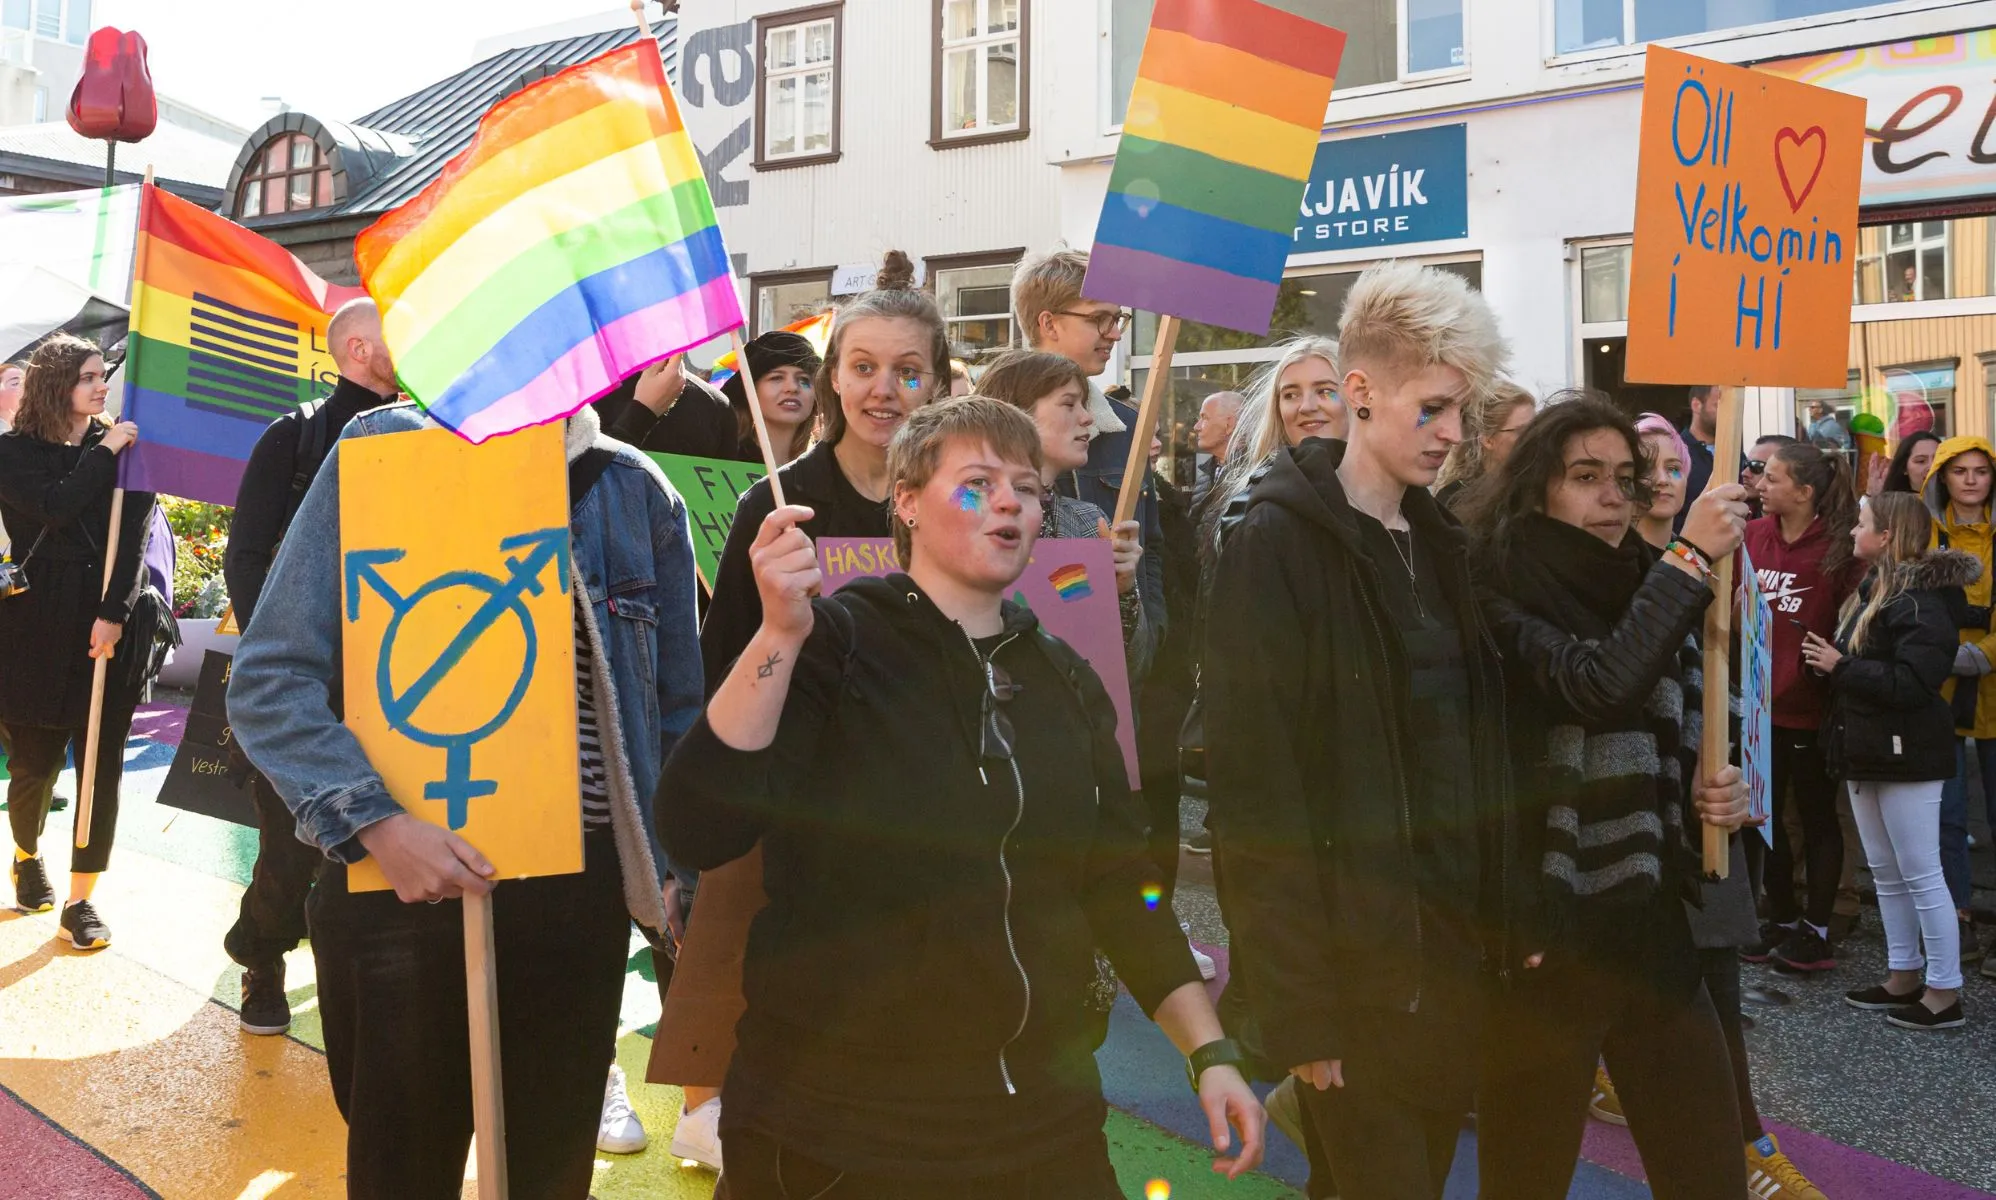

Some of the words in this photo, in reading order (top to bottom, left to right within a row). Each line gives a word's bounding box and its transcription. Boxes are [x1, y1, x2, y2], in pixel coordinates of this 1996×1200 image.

[1672, 65, 1733, 168] Öll
[1315, 215, 1409, 240] STORE
[1675, 181, 1841, 265] Velkomin
[844, 275, 867, 288] ART
[1755, 568, 1797, 595] NIKE
[1777, 595, 1803, 613] SB
